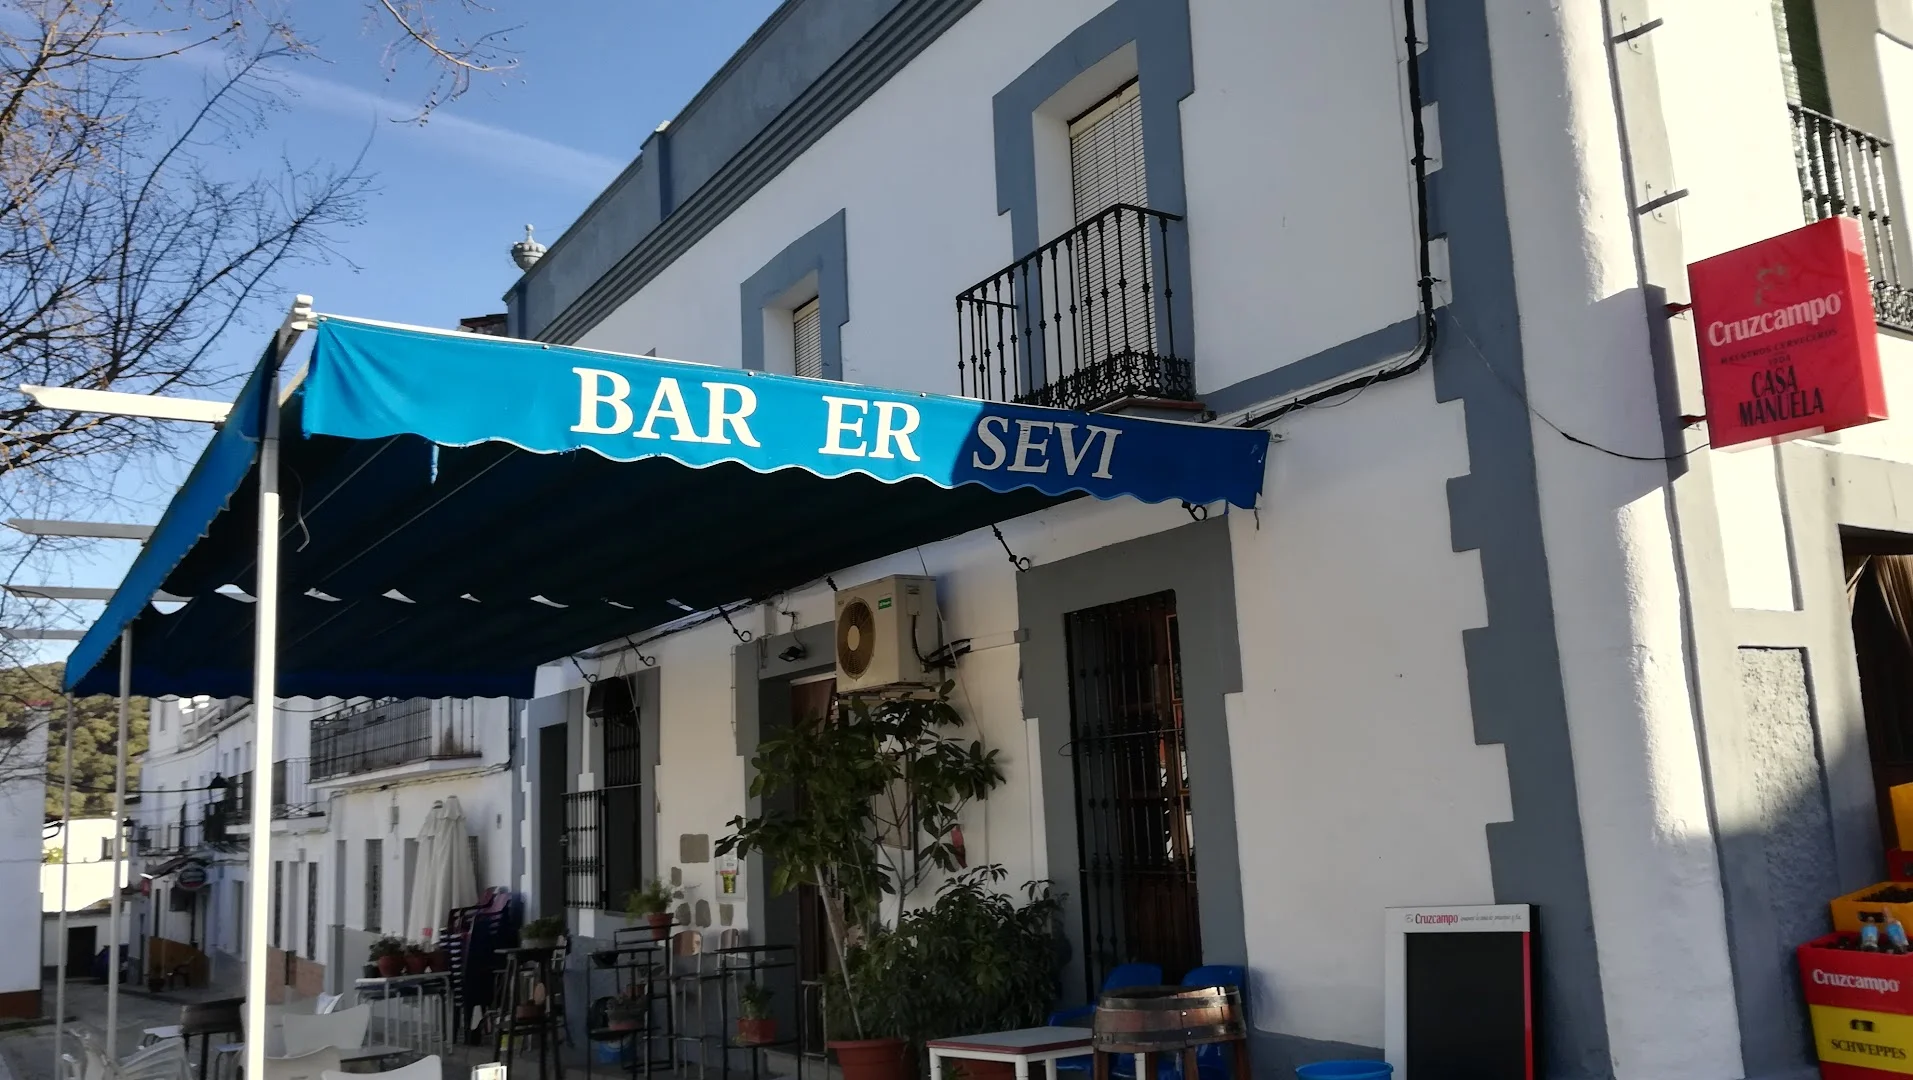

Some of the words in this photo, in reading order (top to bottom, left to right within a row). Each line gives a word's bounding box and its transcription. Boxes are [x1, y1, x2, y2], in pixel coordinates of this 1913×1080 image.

[1708, 293, 1842, 347] Cruzcampo
[1751, 365, 1799, 398] CASA
[570, 366, 762, 448] BAR
[818, 394, 921, 462] ER
[972, 414, 1123, 480] SEVI
[1739, 387, 1825, 428] MANUELA
[1415, 913, 1459, 925] Cruzcampo
[1812, 968, 1899, 993] Cruzcampo
[1831, 1038, 1906, 1059] SCHWEPPES
